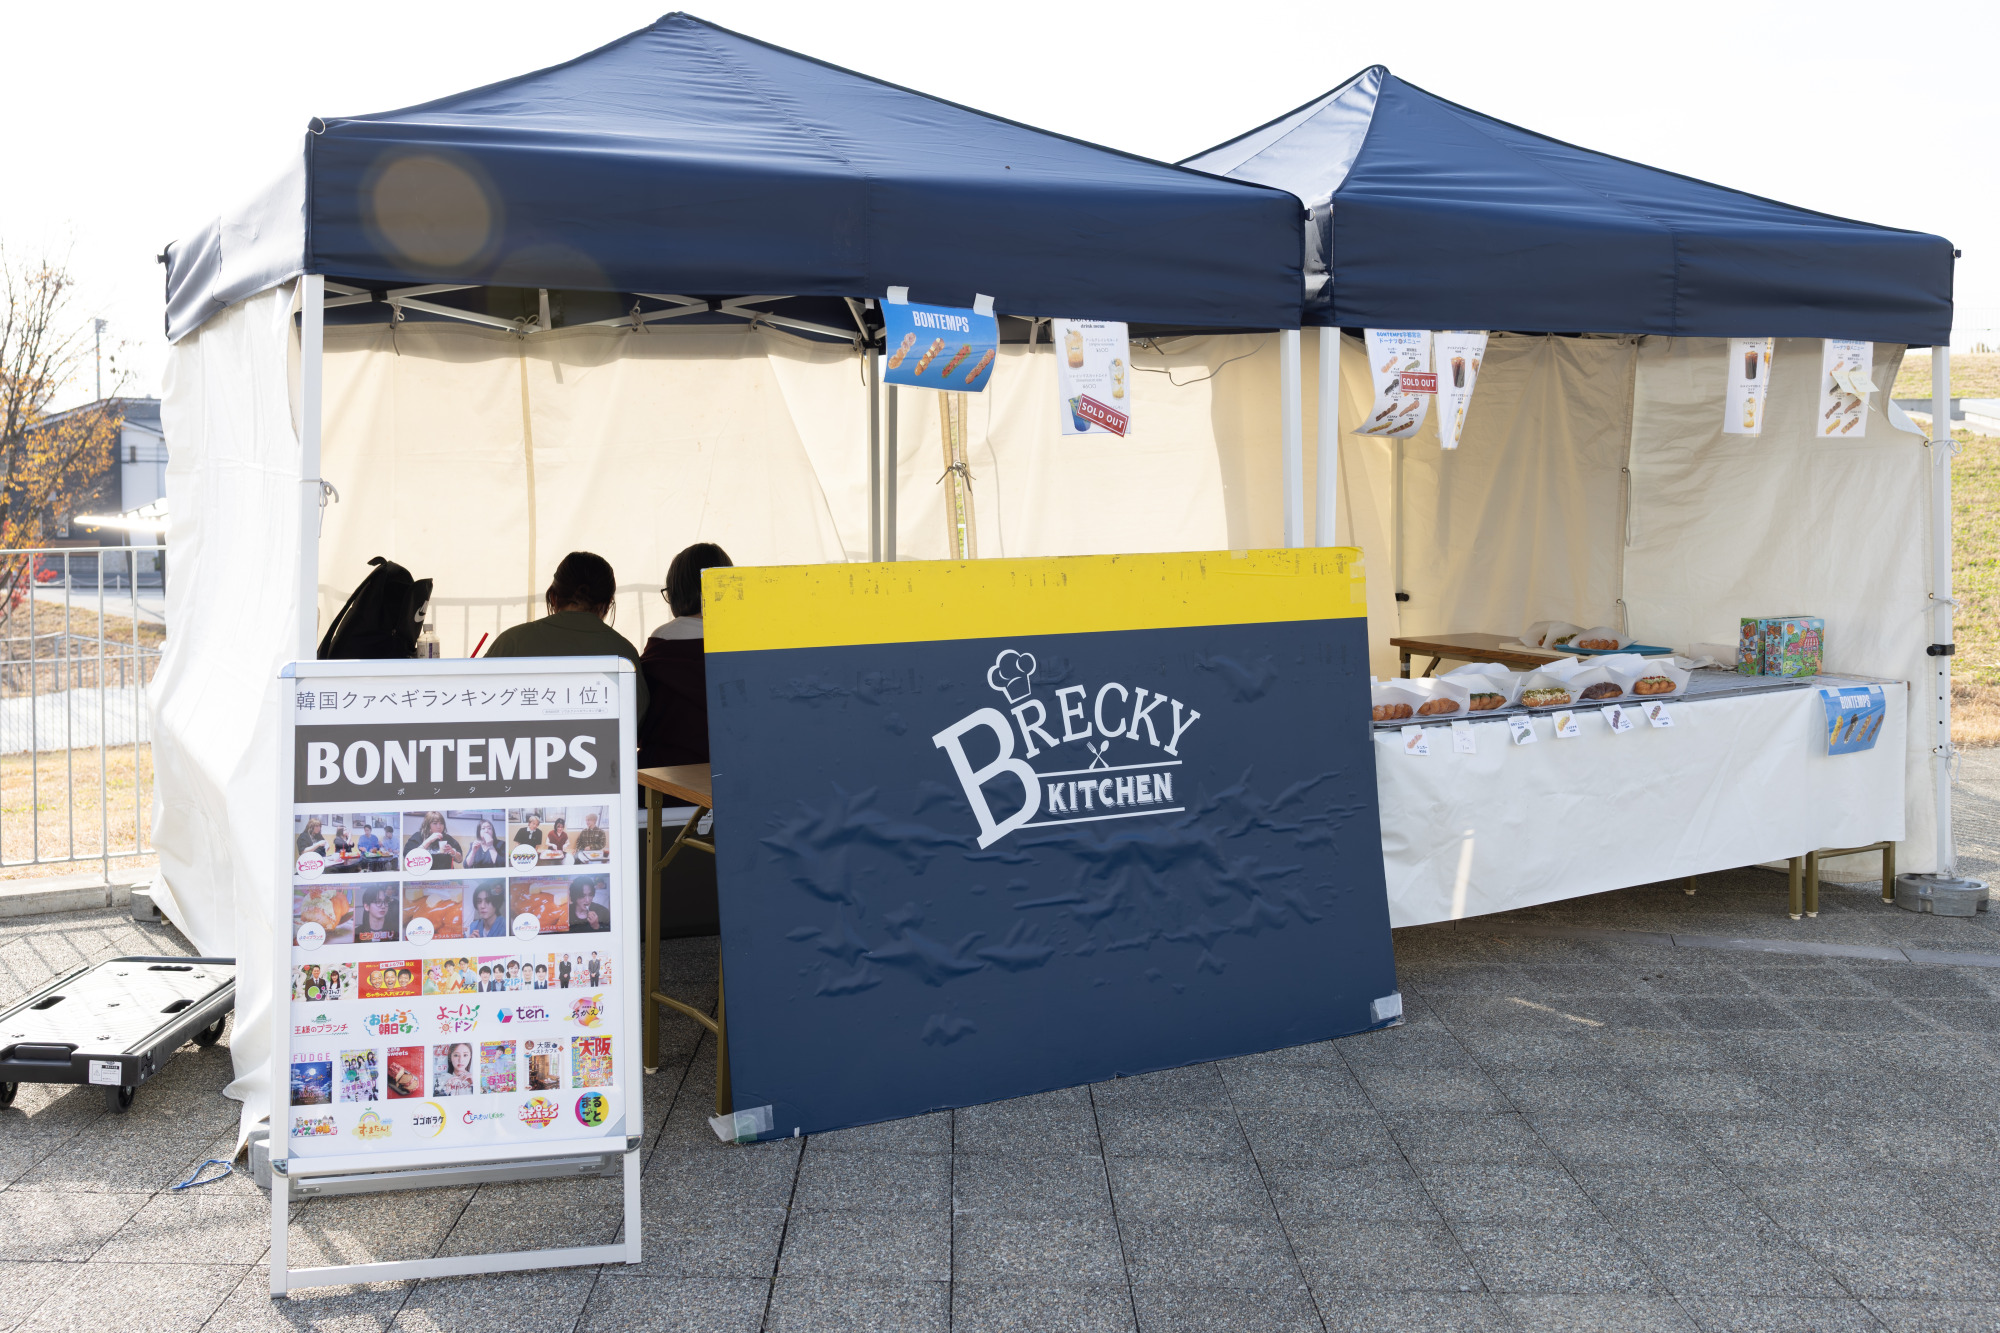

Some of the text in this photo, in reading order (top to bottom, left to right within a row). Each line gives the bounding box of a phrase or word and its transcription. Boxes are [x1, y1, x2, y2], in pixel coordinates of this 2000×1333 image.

[912, 311, 970, 333] BONTEMPS
[1402, 378, 1435, 388] SOLD OUT
[1081, 401, 1125, 430] SOLD OUT
[1840, 695, 1871, 709] BONTEMPS
[307, 735, 598, 786] BONTEMPS
[932, 682, 1201, 850] BRECKY
[1047, 772, 1174, 815] KITCHEN
[504, 978, 523, 987] ZIP!
[368, 1010, 408, 1026] おはよう
[516, 1007, 549, 1020] ten.
[571, 1005, 604, 1019] おかえり
[294, 1023, 349, 1035] 王様のブランチ
[378, 1023, 414, 1035] 朝日です
[578, 1038, 612, 1056] 大阪
[293, 1053, 331, 1062] FUDGE
[581, 1096, 602, 1108] まる
[581, 1110, 602, 1123] ごと
